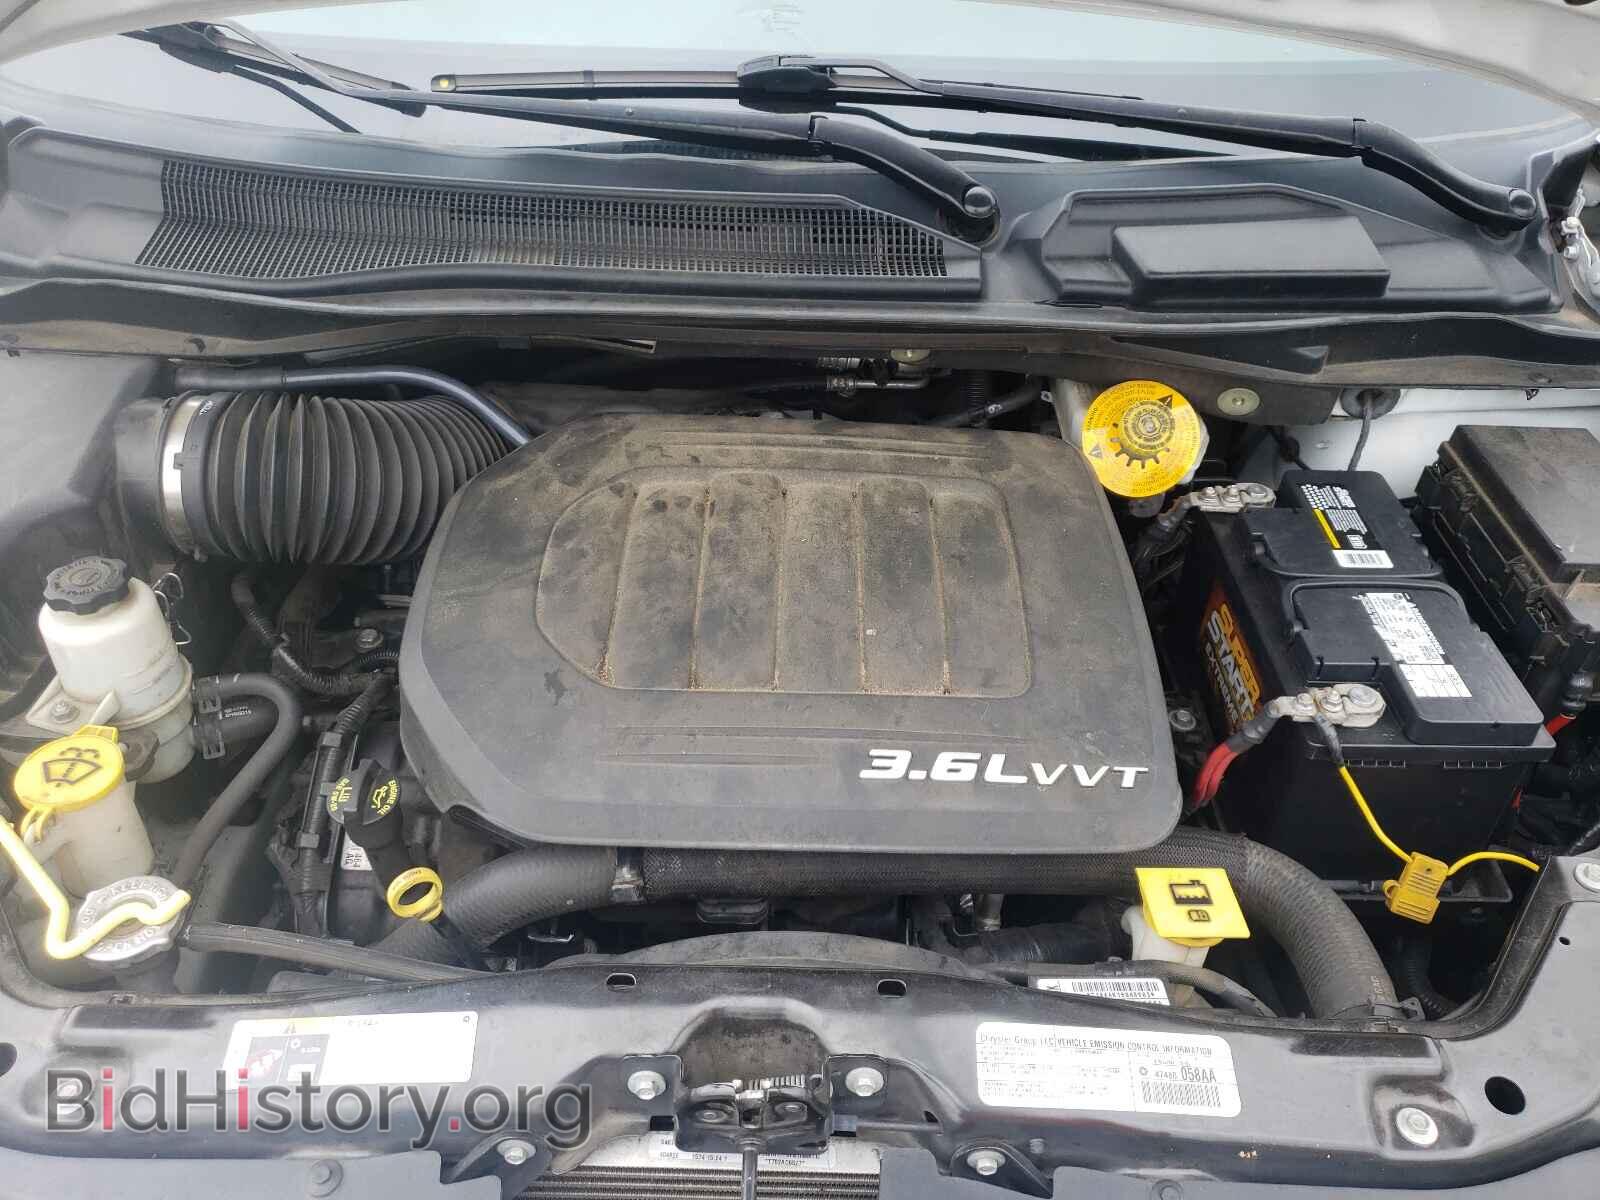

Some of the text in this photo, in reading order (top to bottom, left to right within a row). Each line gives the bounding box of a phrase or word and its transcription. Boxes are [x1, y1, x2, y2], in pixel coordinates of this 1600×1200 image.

[1219, 602, 1260, 705] SUPER
[859, 748, 1150, 789] 3.6L VVT
[376, 779, 398, 816] ENGINE OIL
[1089, 1039, 1125, 1049] EMISSION
